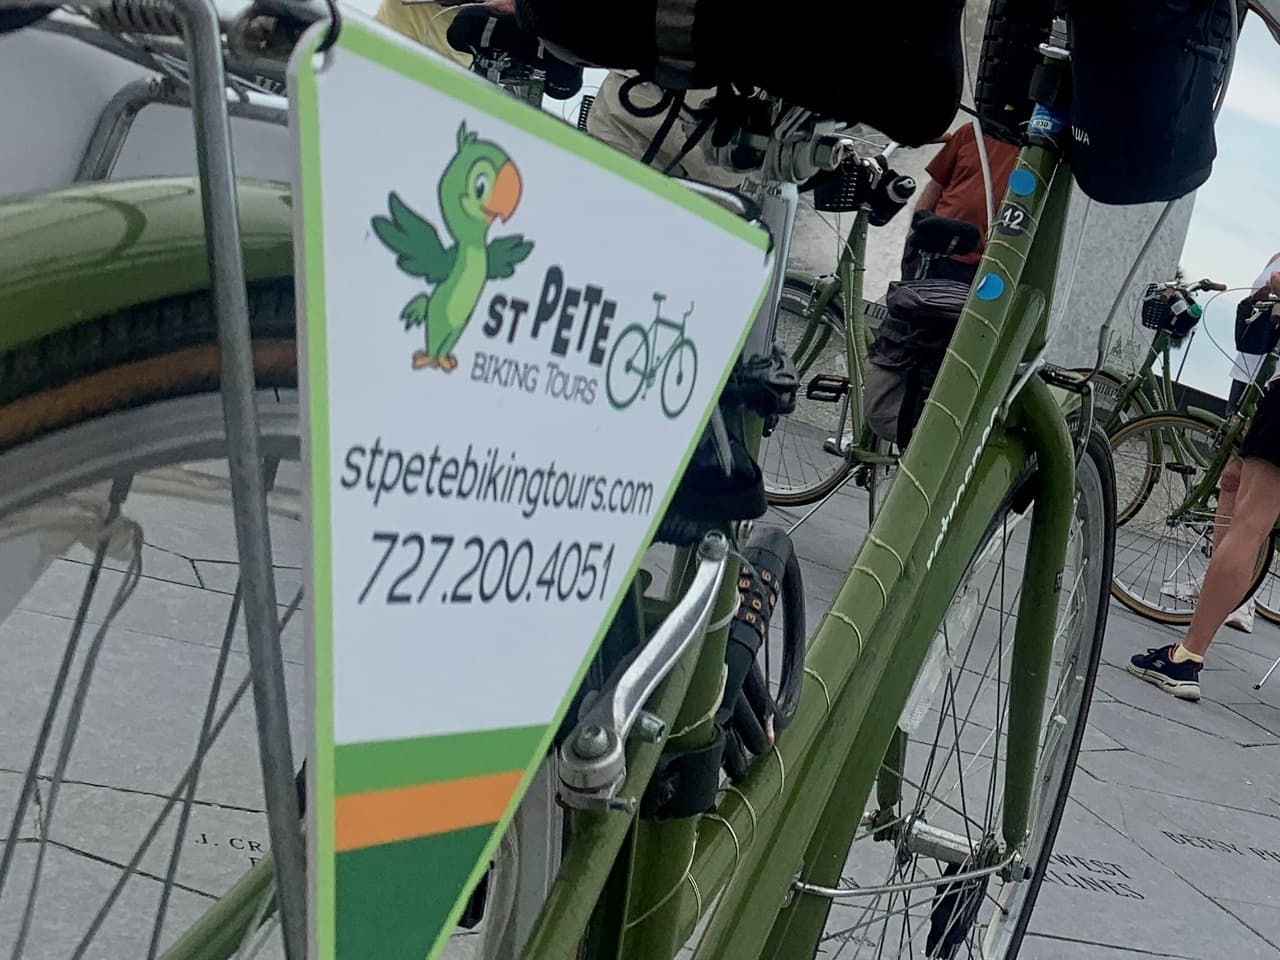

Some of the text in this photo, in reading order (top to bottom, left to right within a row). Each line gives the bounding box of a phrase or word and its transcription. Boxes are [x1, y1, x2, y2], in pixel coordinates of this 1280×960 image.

[1002, 207, 1025, 231] 12
[482, 264, 617, 368] ST PETE
[470, 352, 599, 406] BIKING TOURS
[341, 437, 654, 519] stpetebikingtours.com
[357, 530, 616, 604] 727.200.4051
[229, 837, 265, 854] CR
[1161, 829, 1245, 856] BETSY
